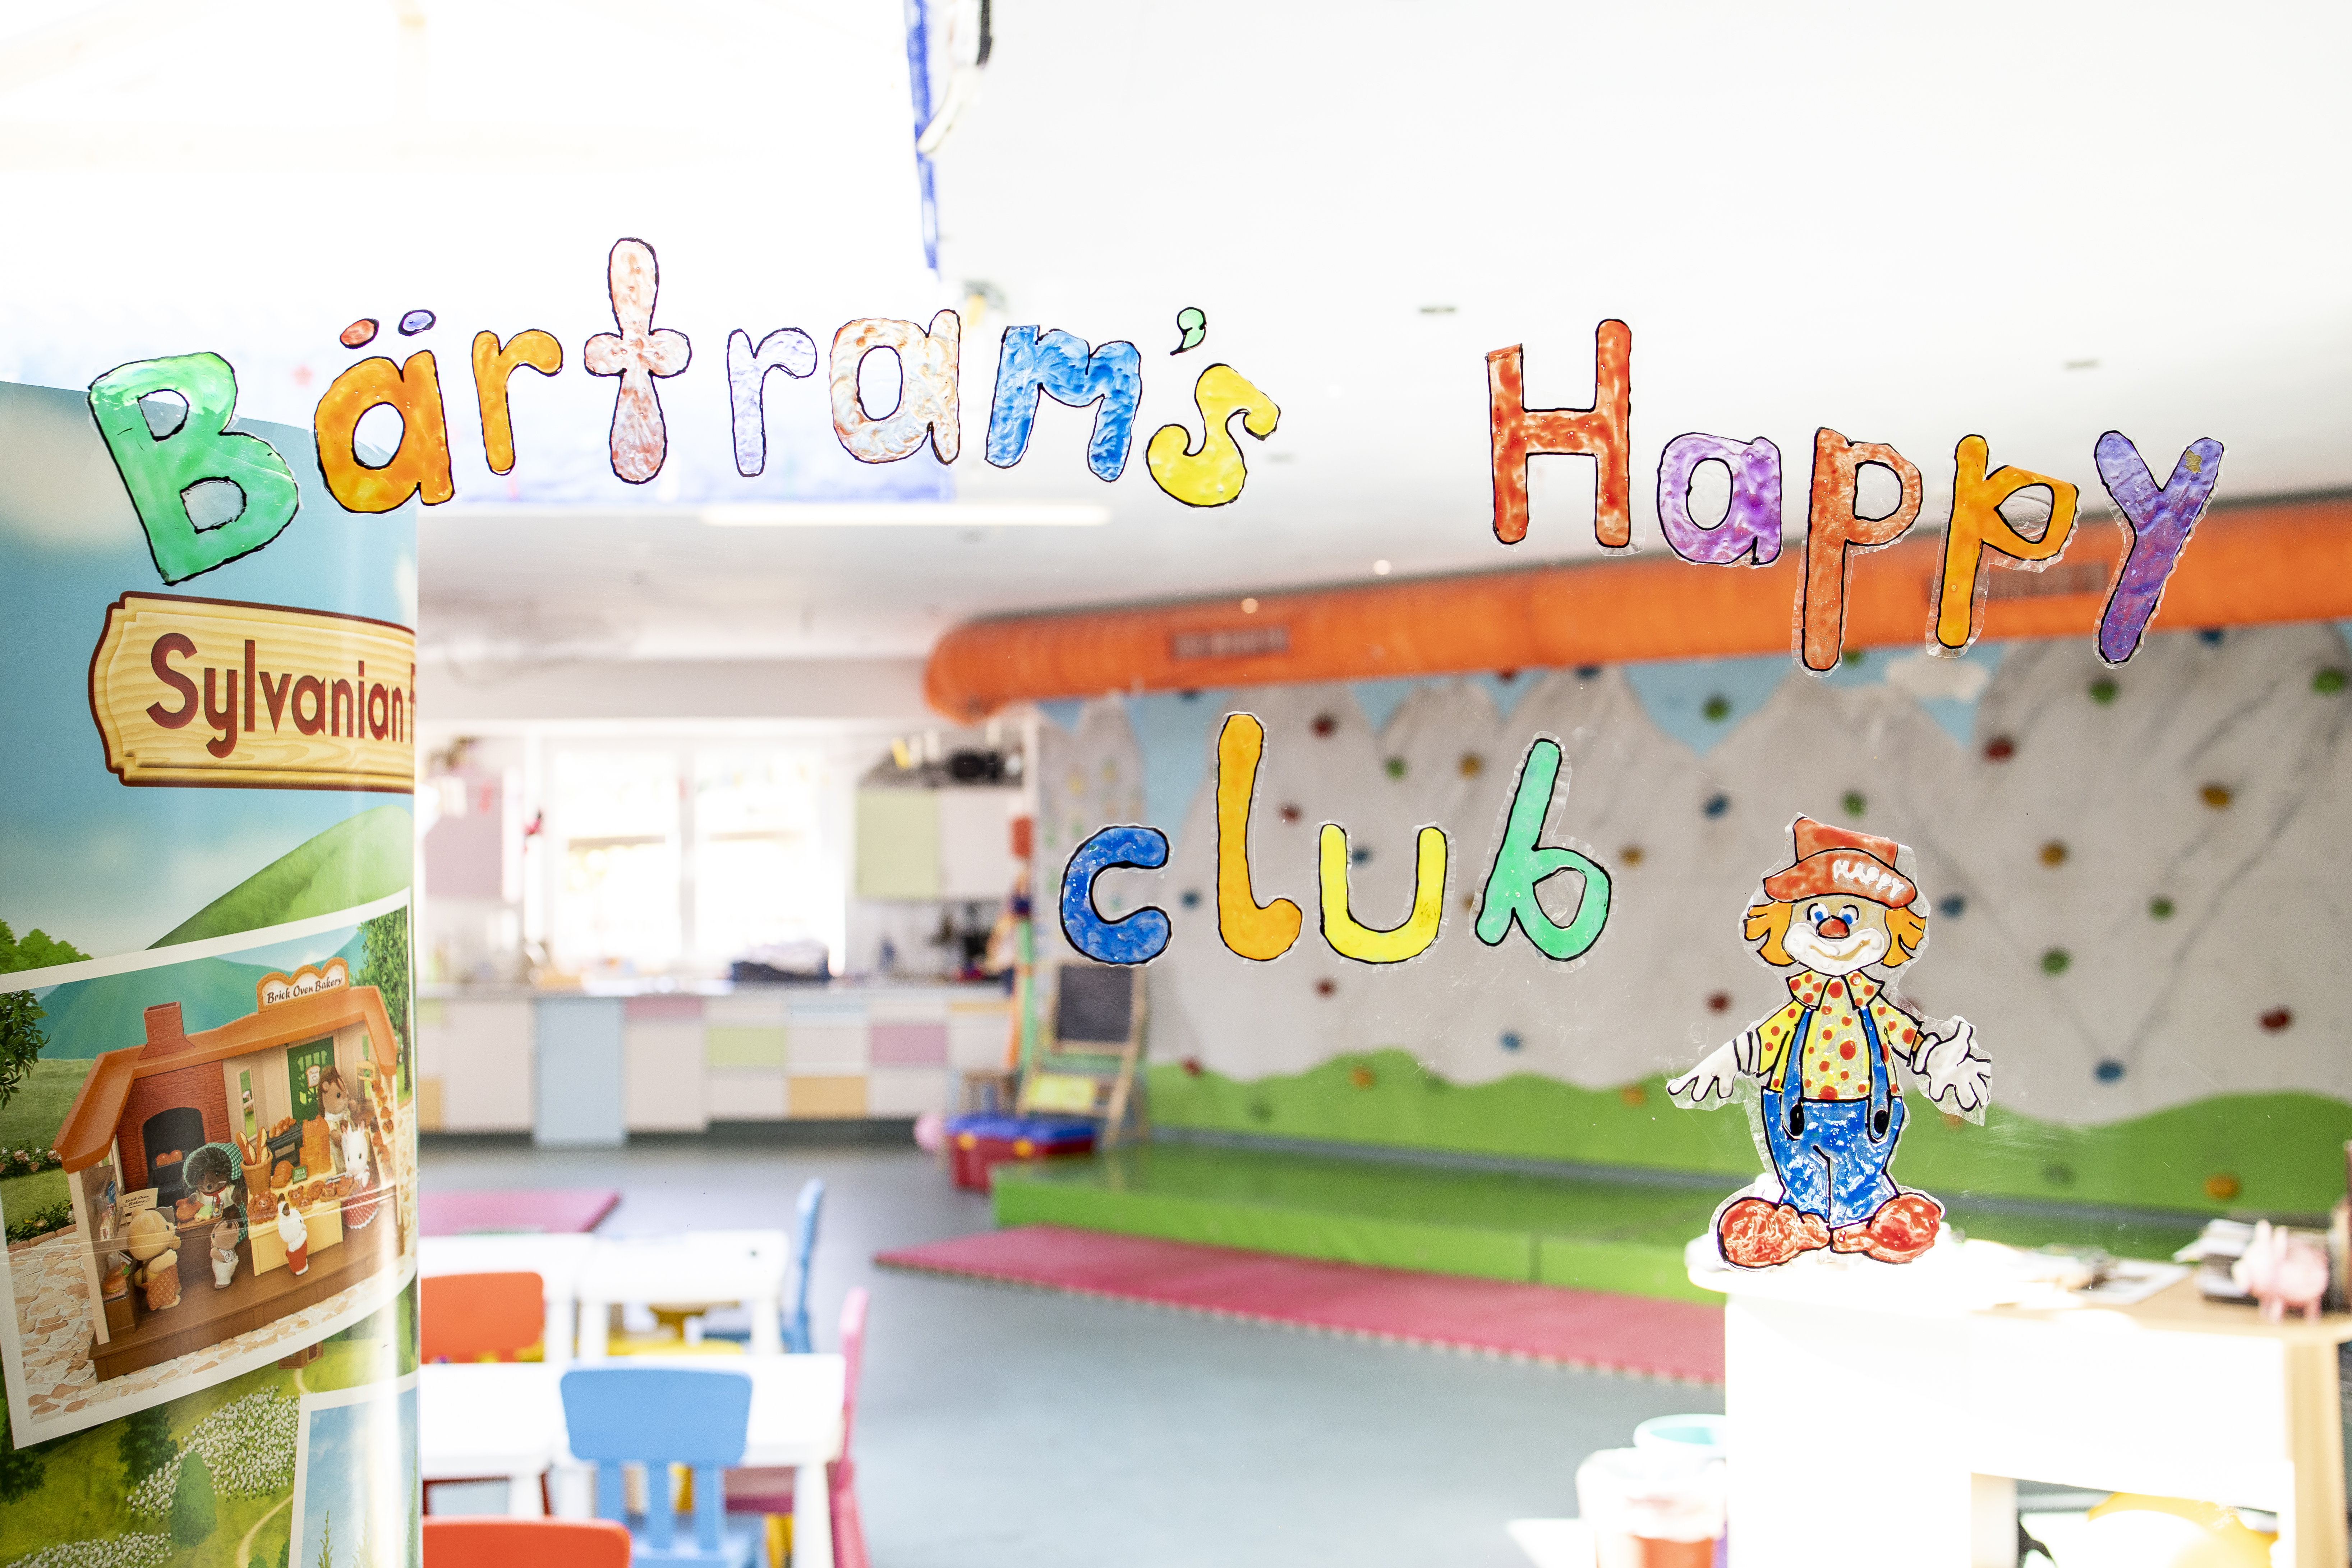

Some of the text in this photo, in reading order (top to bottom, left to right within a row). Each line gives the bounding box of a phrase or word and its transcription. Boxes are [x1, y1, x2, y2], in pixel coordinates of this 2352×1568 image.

[88, 237, 2225, 672] Bärtram's Happy
[145, 633, 403, 758] Sylvanian
[1059, 713, 1613, 965] club
[1832, 859, 1905, 899] HAPPY
[267, 976, 342, 1004] Brick Oven Bakery
